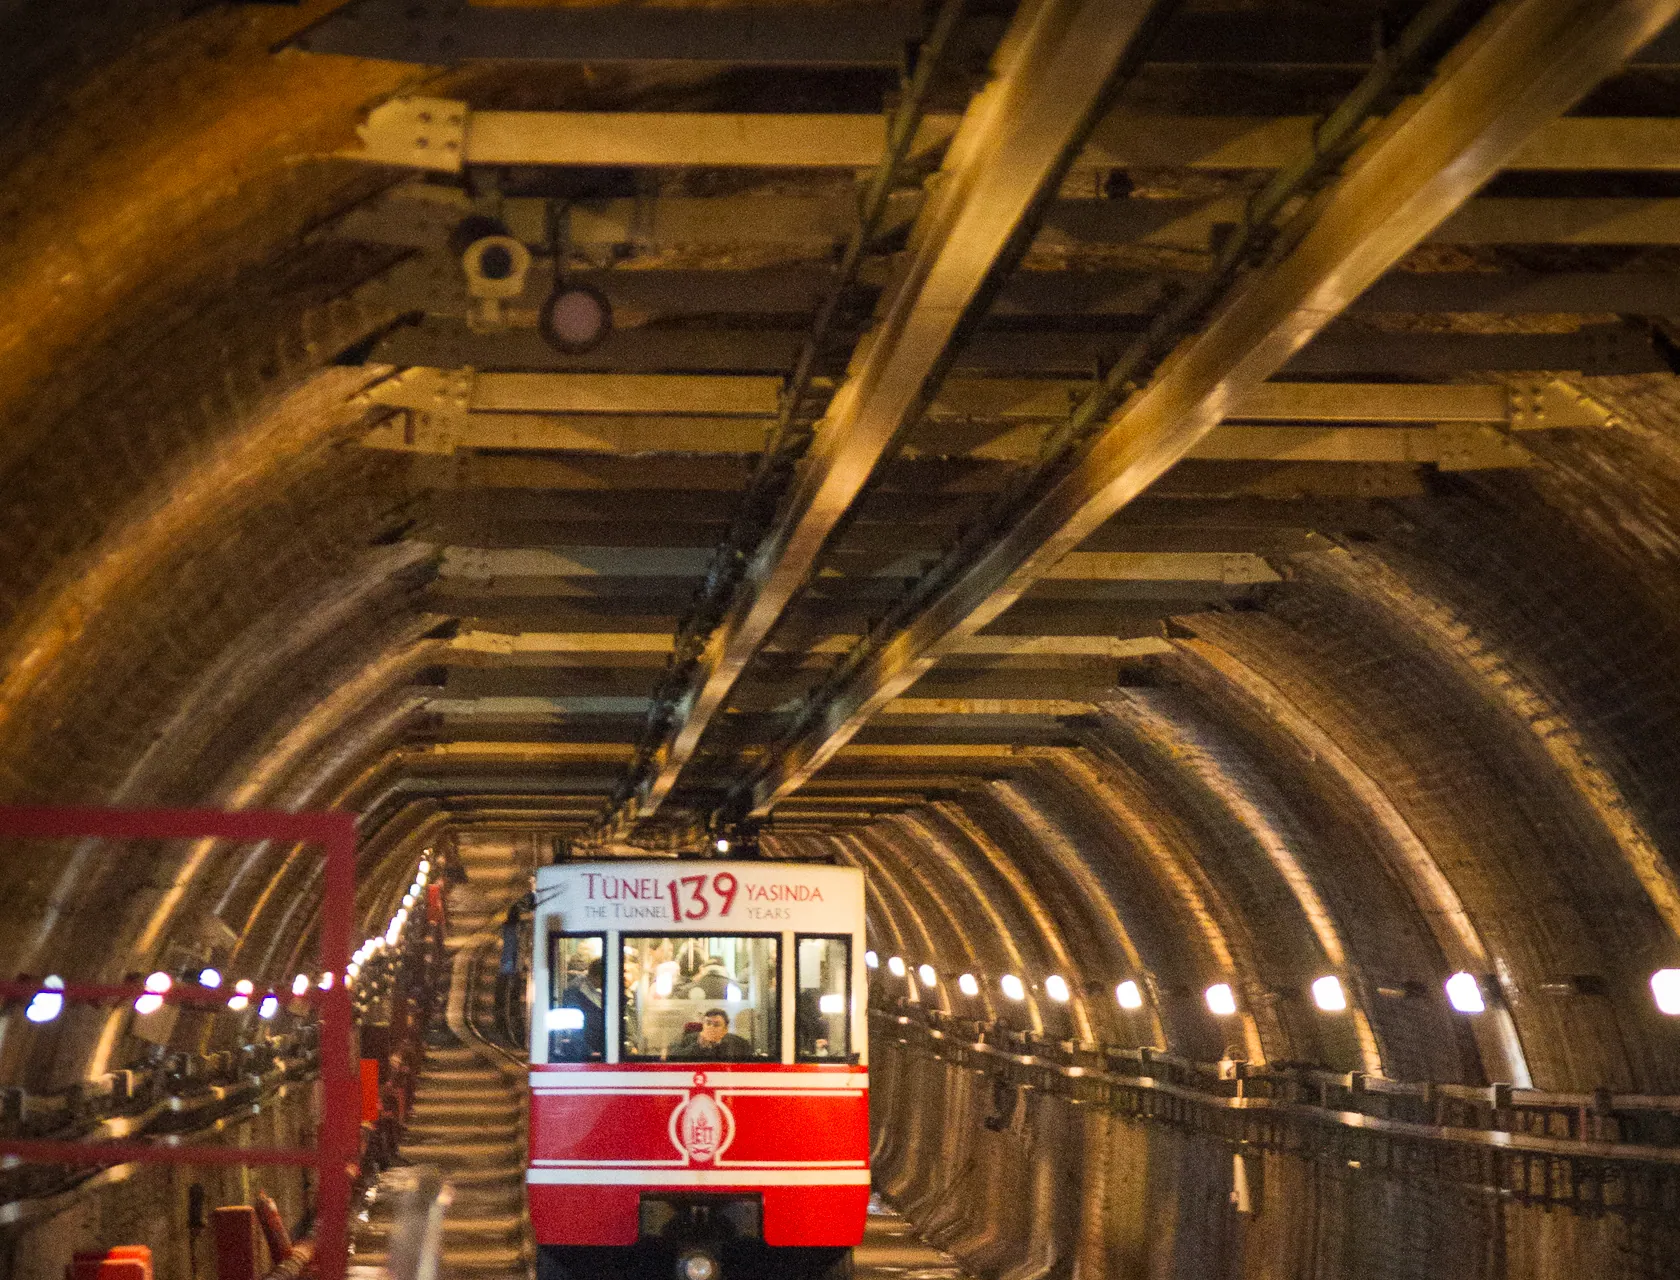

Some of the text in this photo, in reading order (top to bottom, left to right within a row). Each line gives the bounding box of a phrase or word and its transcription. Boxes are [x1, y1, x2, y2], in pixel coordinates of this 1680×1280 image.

[584, 903, 791, 920] THE TUNNEL YEARS
[667, 871, 738, 922] 139
